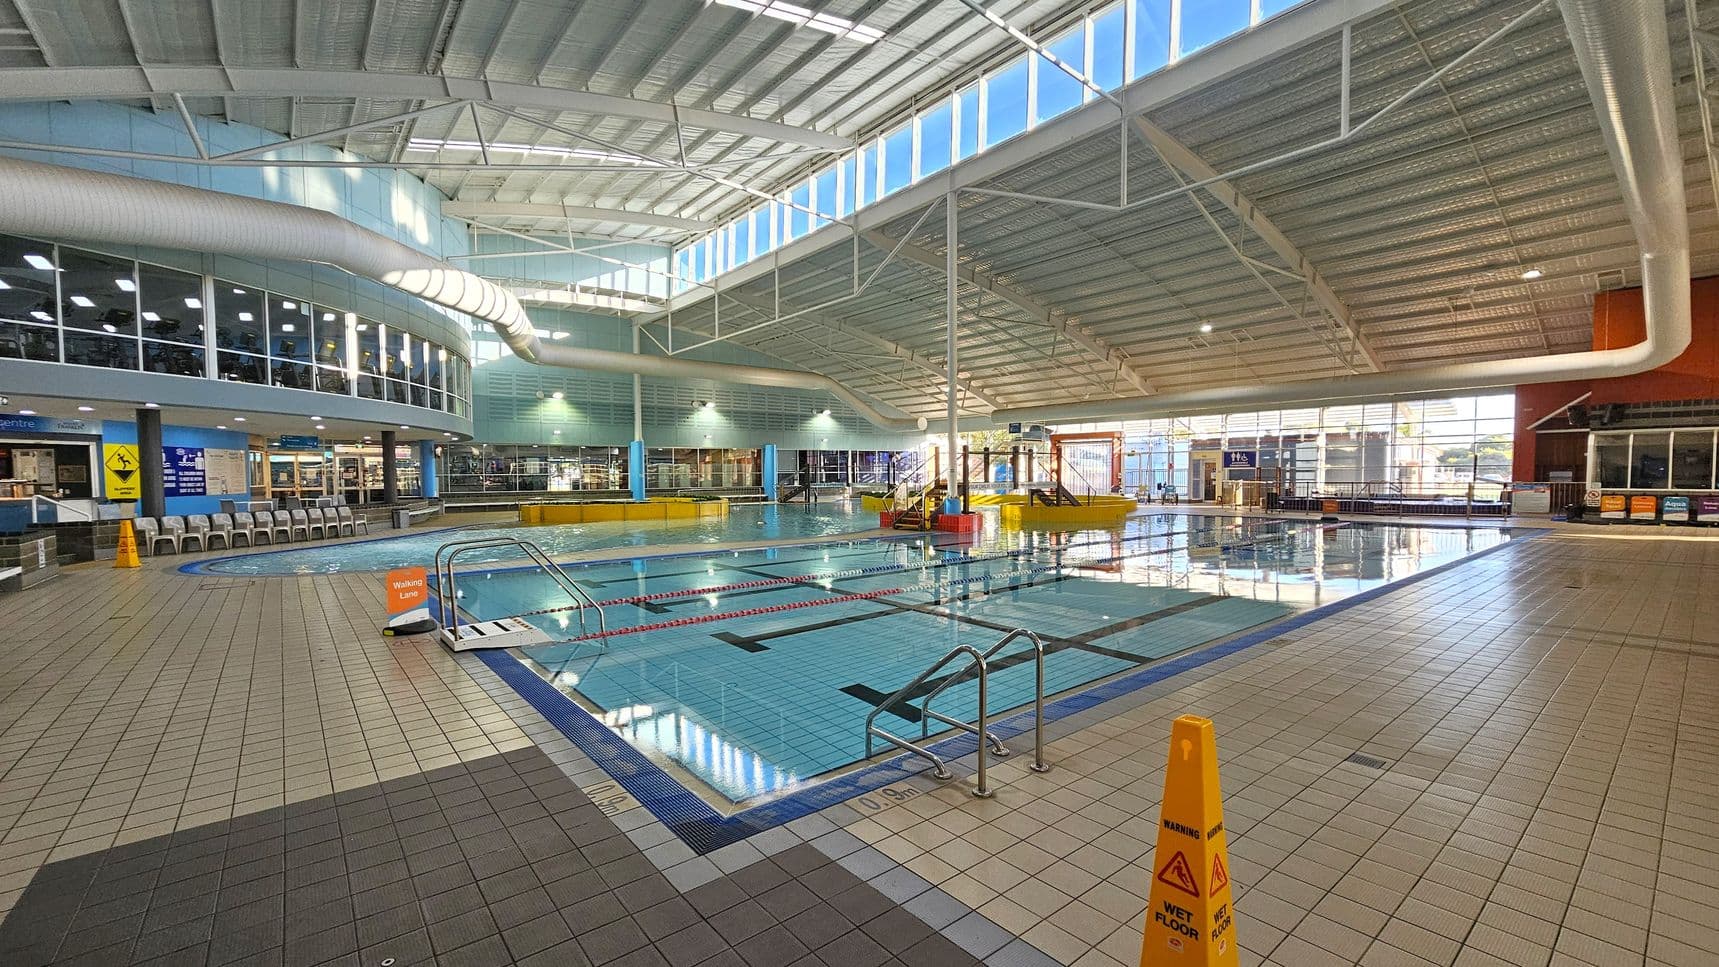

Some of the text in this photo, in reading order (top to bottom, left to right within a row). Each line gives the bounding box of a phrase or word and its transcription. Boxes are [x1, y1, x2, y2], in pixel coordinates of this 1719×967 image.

[1664, 500, 1687, 508] Aqua
[393, 579, 423, 589] Walking
[400, 590, 419, 600] Lane
[1163, 818, 1200, 840] WARNING
[1163, 900, 1194, 923] WET
[1213, 903, 1227, 924] WET
[1155, 911, 1199, 941] FLOOR
[1211, 915, 1231, 942] FLOOR
